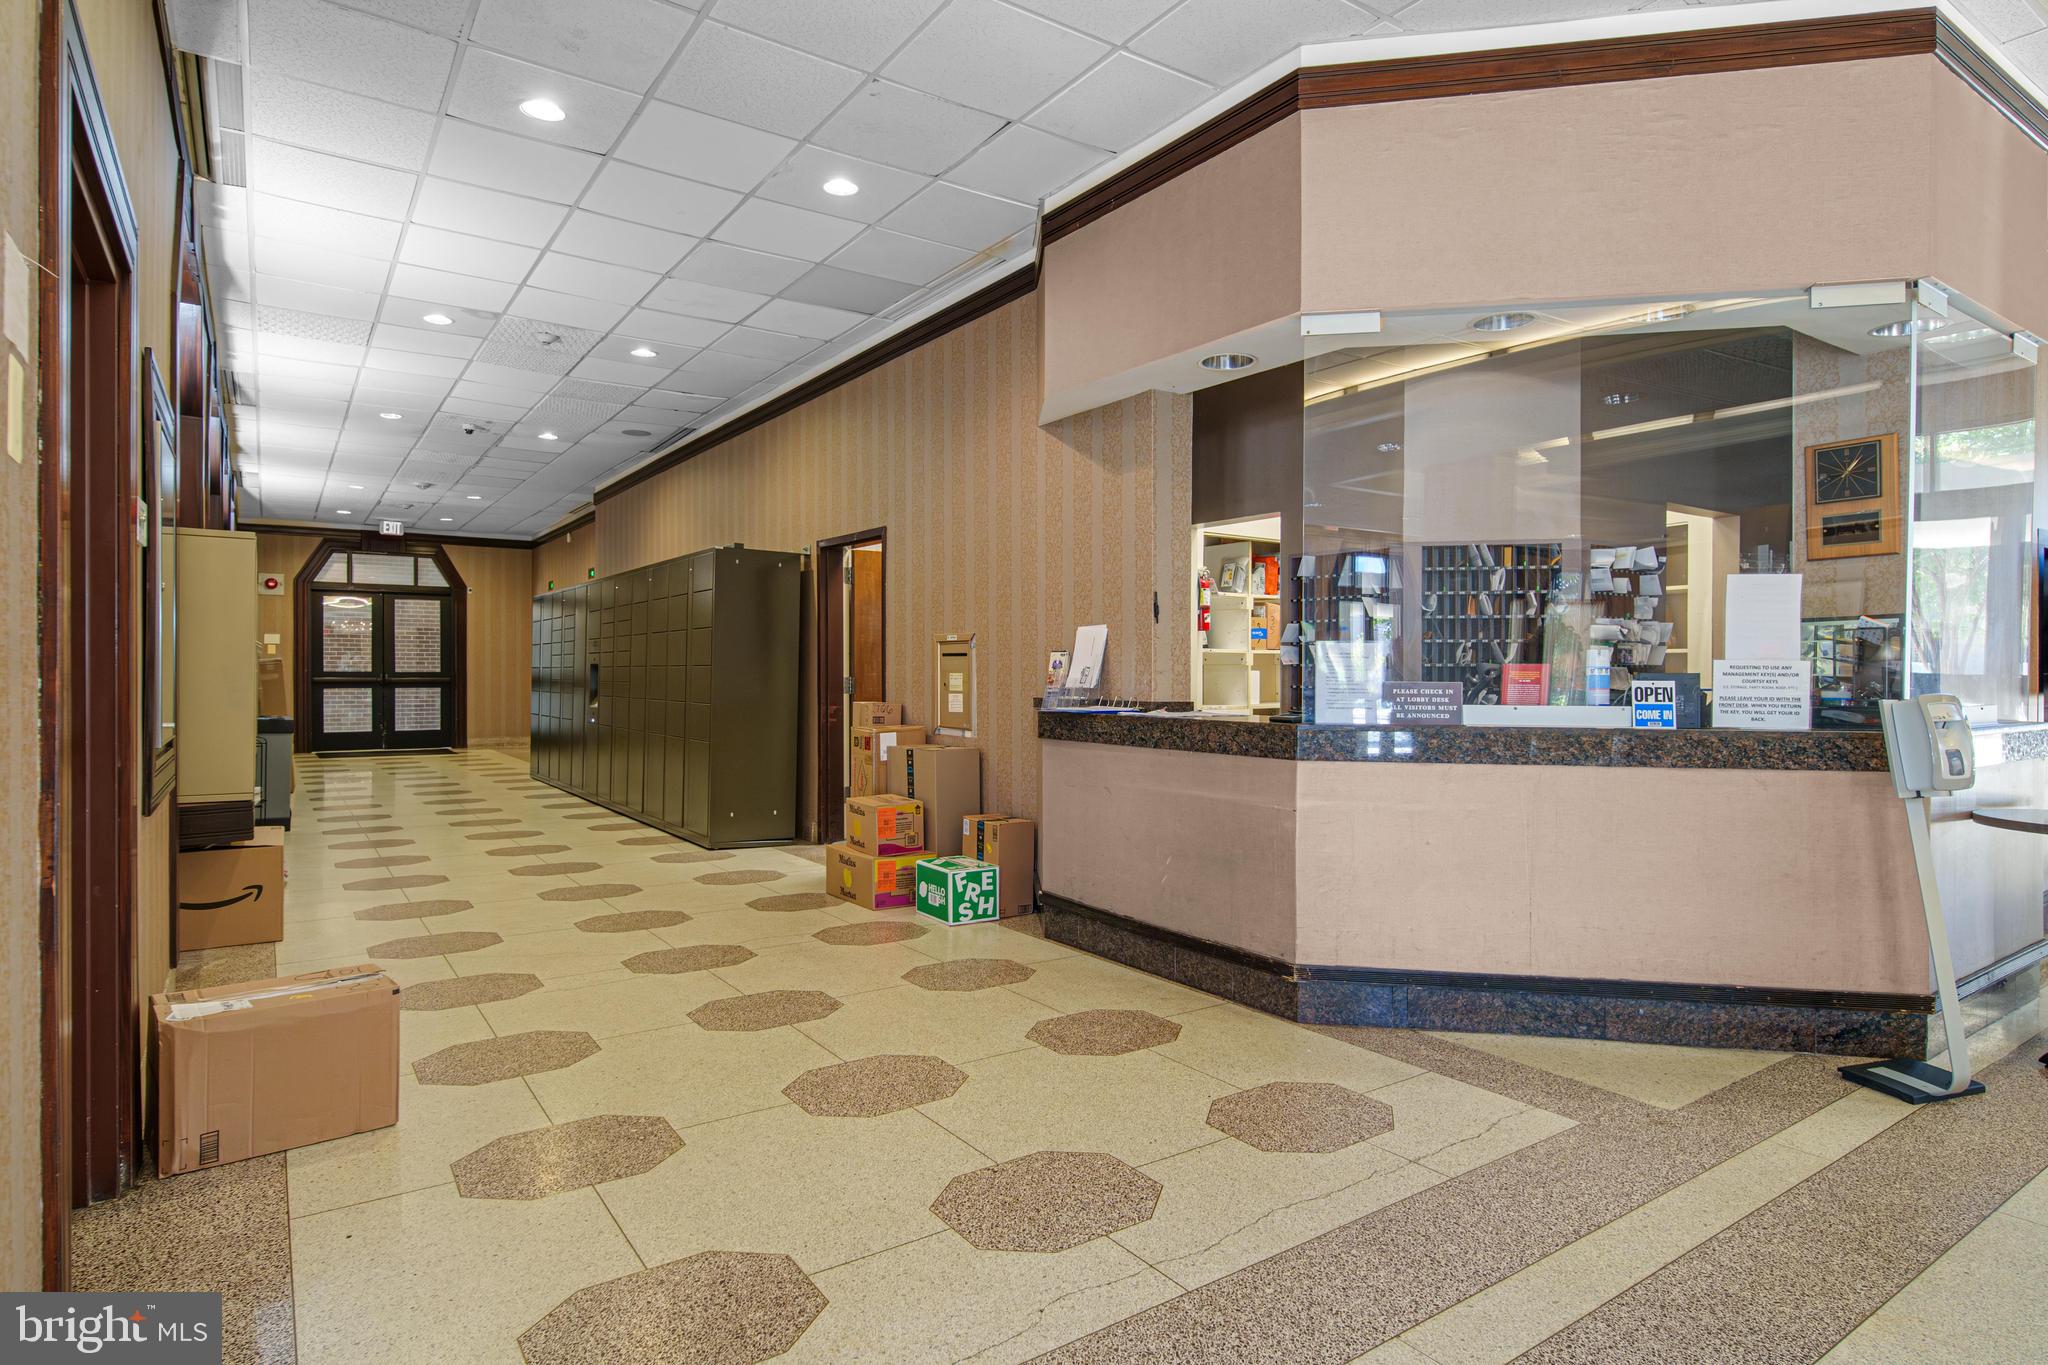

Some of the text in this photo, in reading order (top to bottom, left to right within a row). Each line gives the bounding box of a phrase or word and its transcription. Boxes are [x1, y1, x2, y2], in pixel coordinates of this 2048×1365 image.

[383, 520, 402, 535] EXIT
[1634, 686, 1673, 703] OPEN
[1636, 709, 1673, 720] COME IN
[838, 853, 857, 868] Misfits
[839, 885, 857, 901] Market
[928, 883, 946, 896] HELLO
